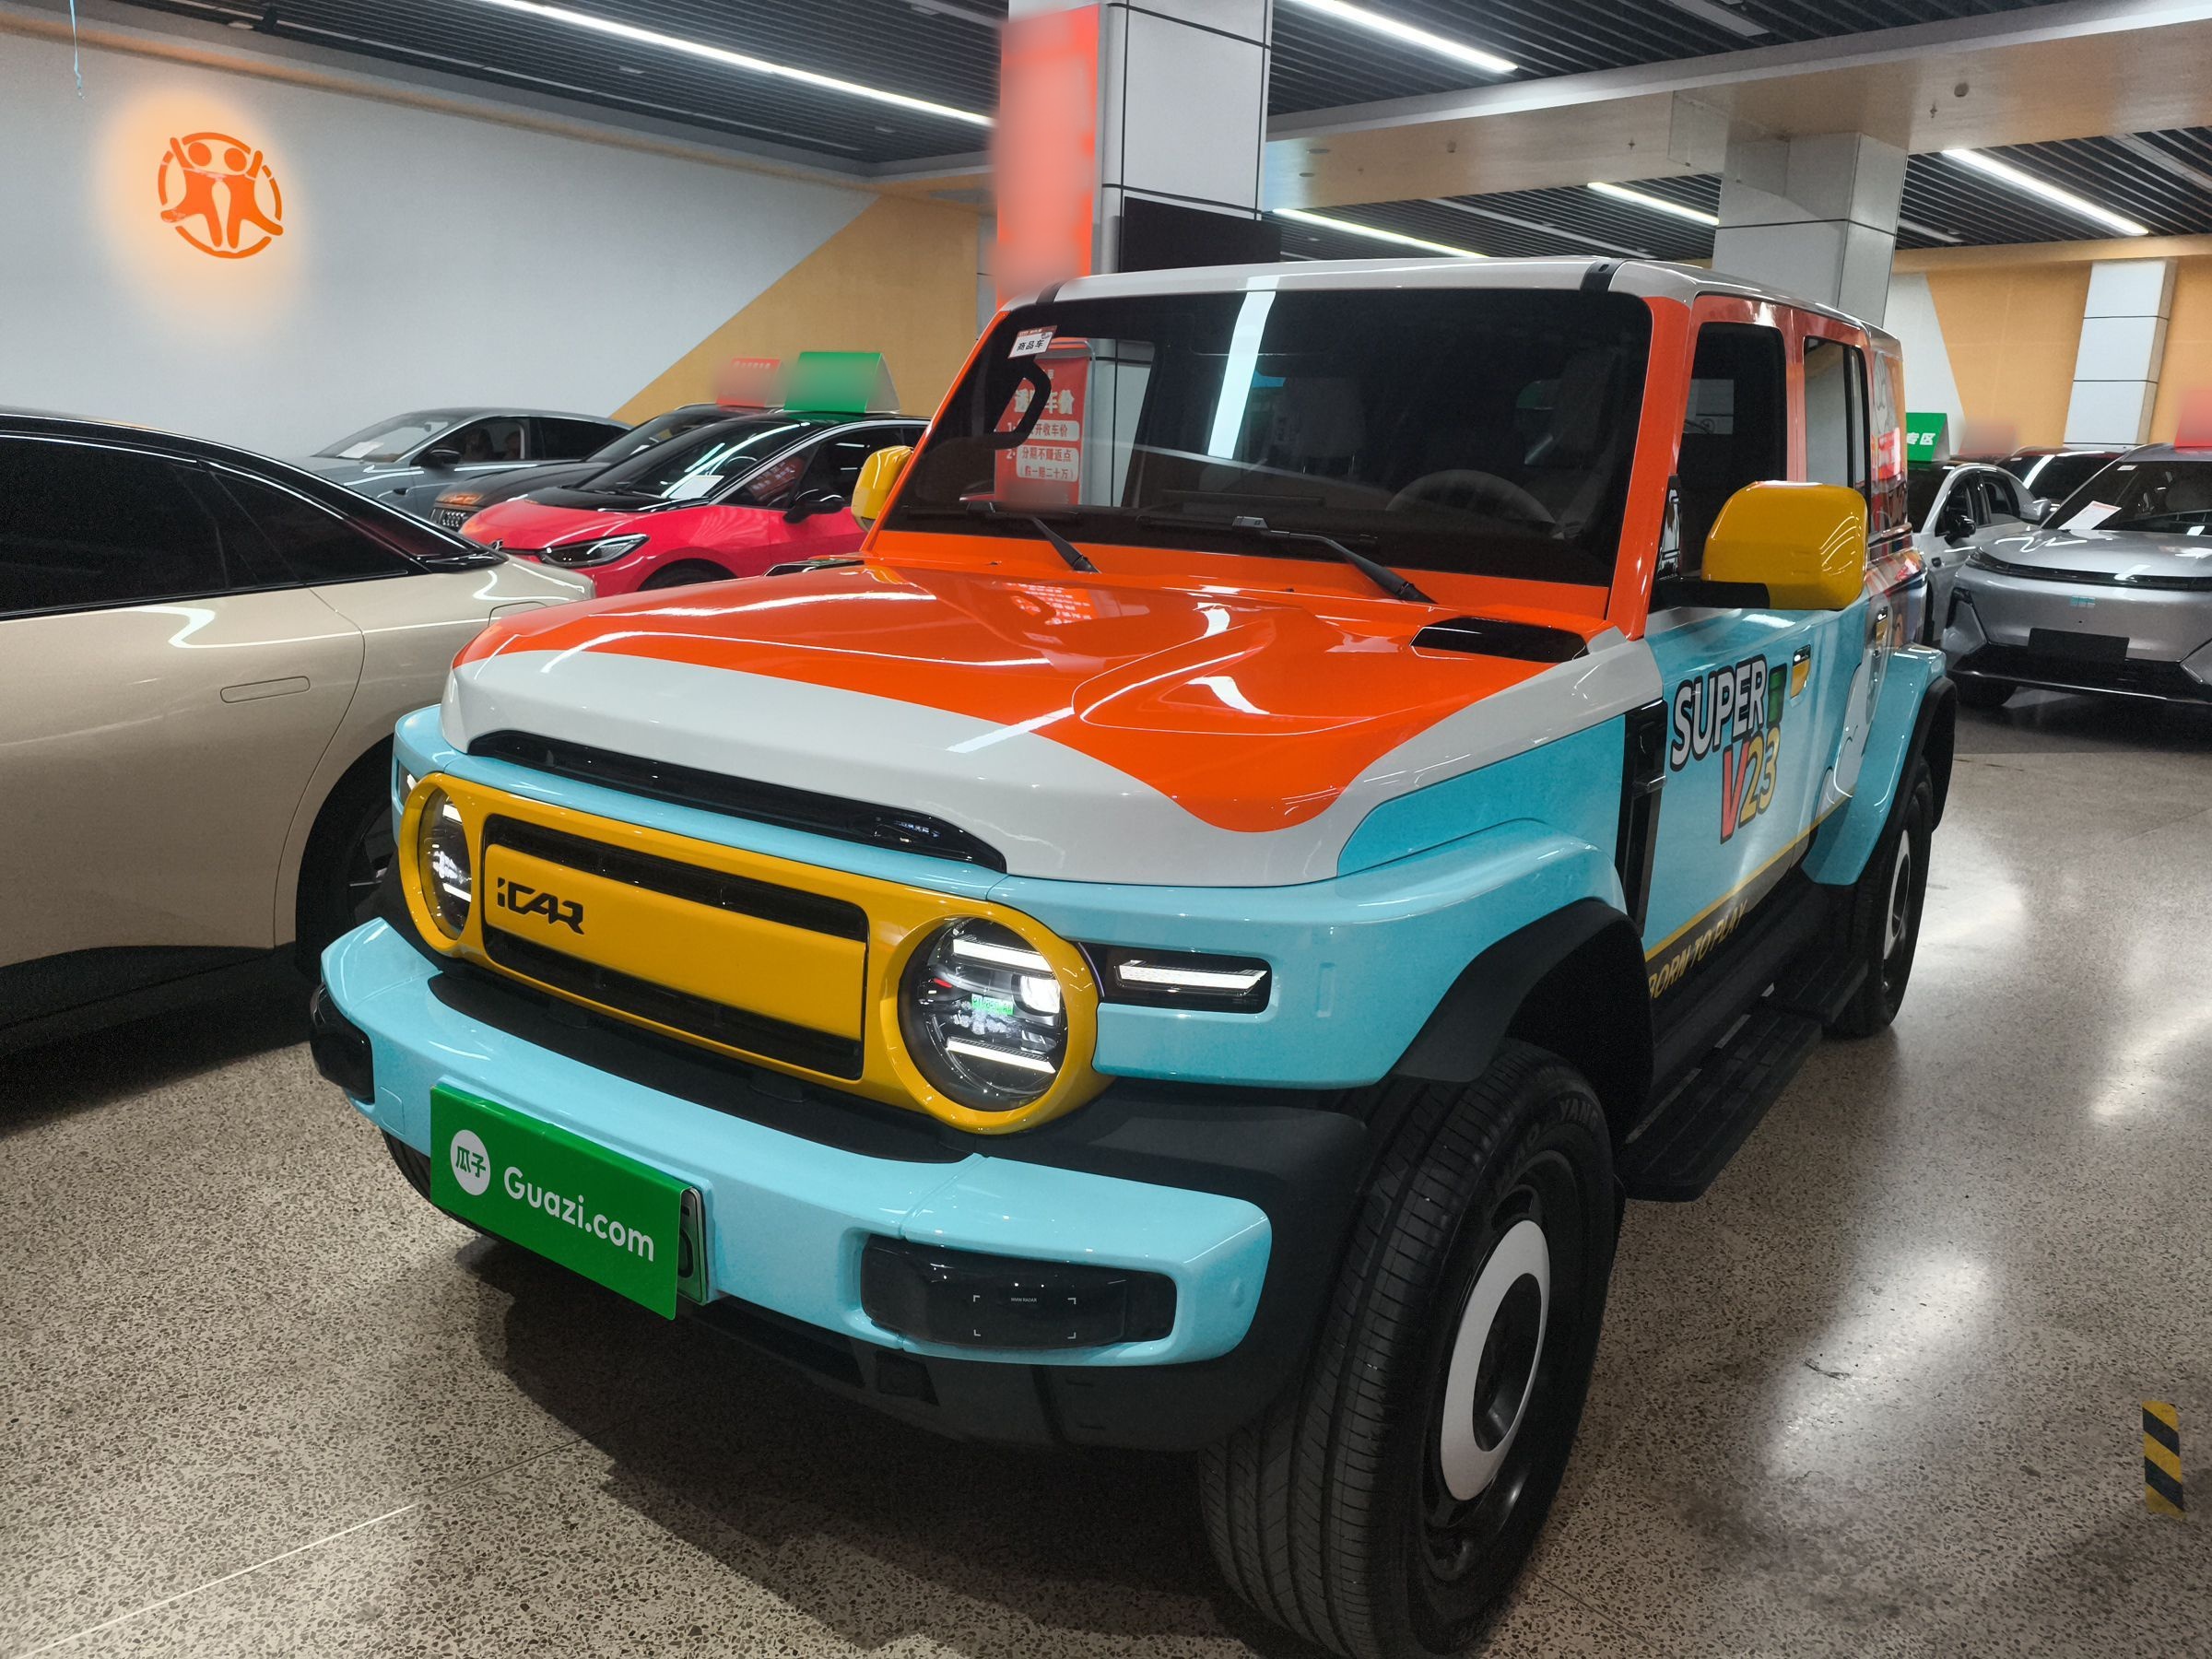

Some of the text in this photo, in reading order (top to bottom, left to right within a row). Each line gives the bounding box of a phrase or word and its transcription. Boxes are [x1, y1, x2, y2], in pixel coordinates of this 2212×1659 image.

[1017, 339, 1044, 351] 商品车
[1029, 424, 1068, 438] 开收车价
[1671, 654, 1767, 771] SUPER
[1720, 725, 1781, 844] V23
[1648, 899, 1748, 999] BORN TO PLAY
[455, 1146, 487, 1178] 瓜子
[503, 1166, 654, 1262] Guazi.com
